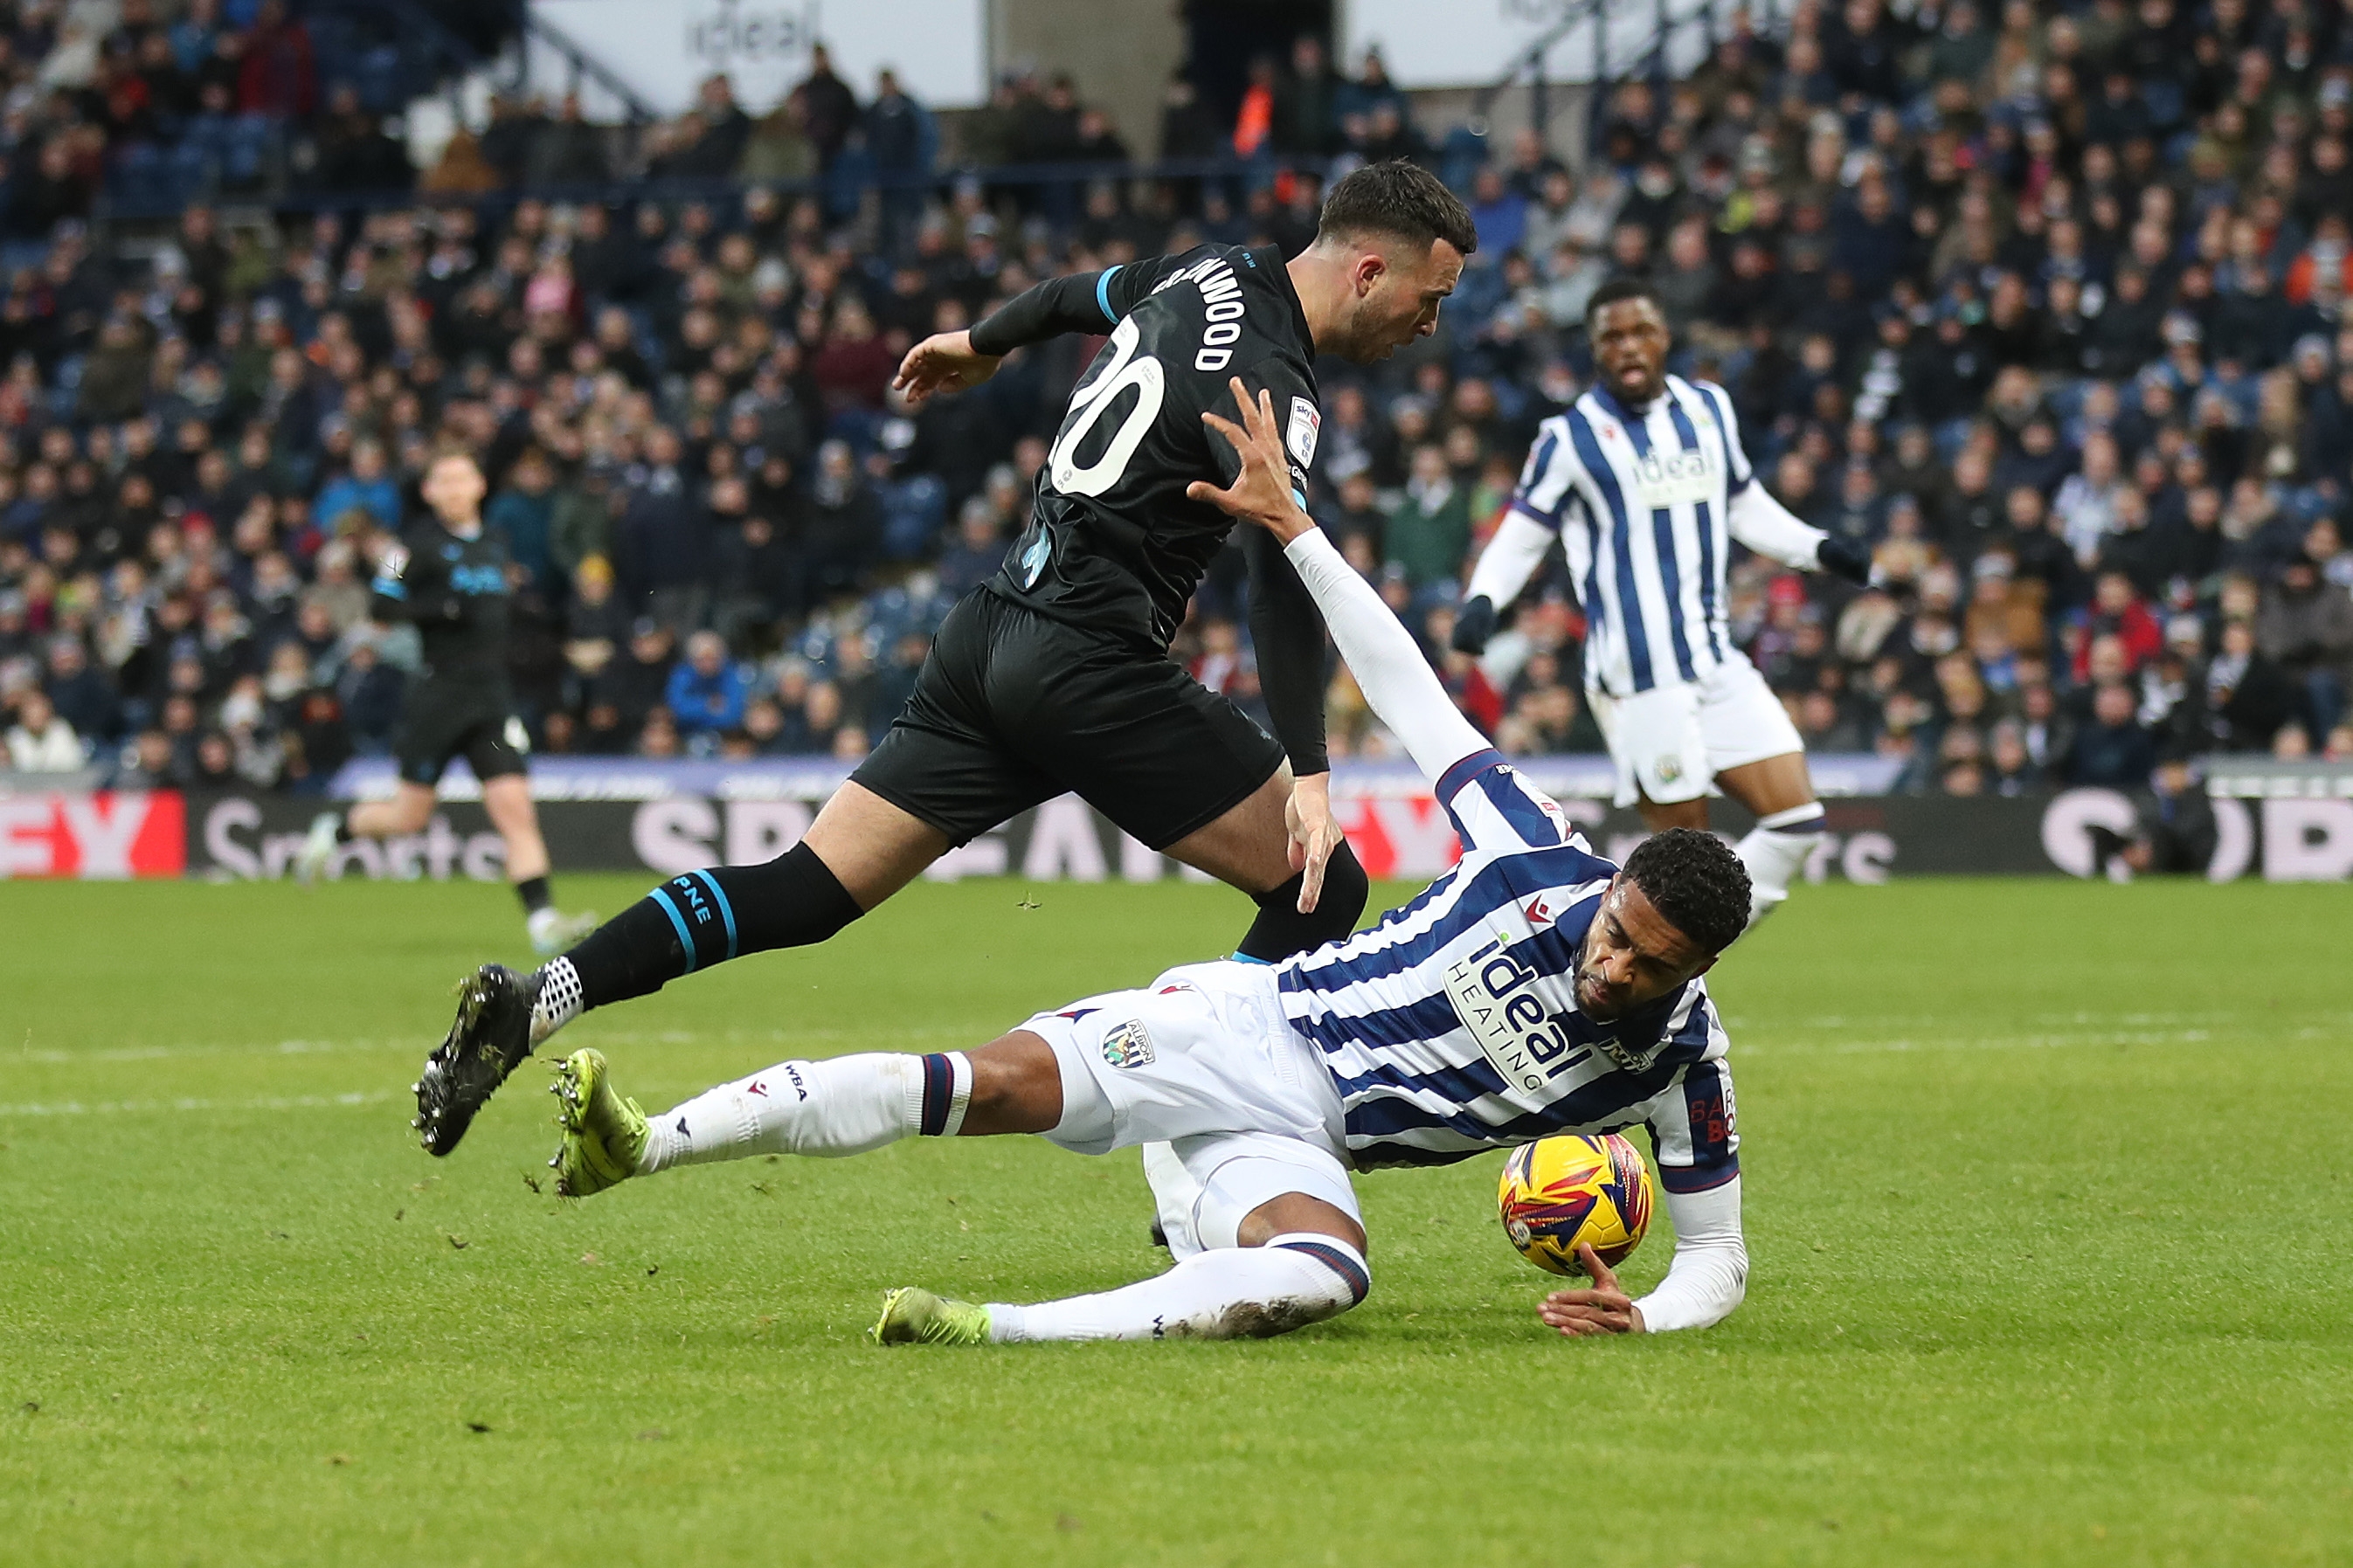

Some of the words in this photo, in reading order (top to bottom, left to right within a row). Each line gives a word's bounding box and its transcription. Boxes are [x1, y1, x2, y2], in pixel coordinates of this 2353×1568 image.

[672, 875, 712, 925] PNE
[1447, 961, 1543, 1091] HEATING
[1468, 931, 1594, 1081] ideal
[1128, 1023, 1153, 1062] ALBION
[785, 1064, 808, 1102] WBA
